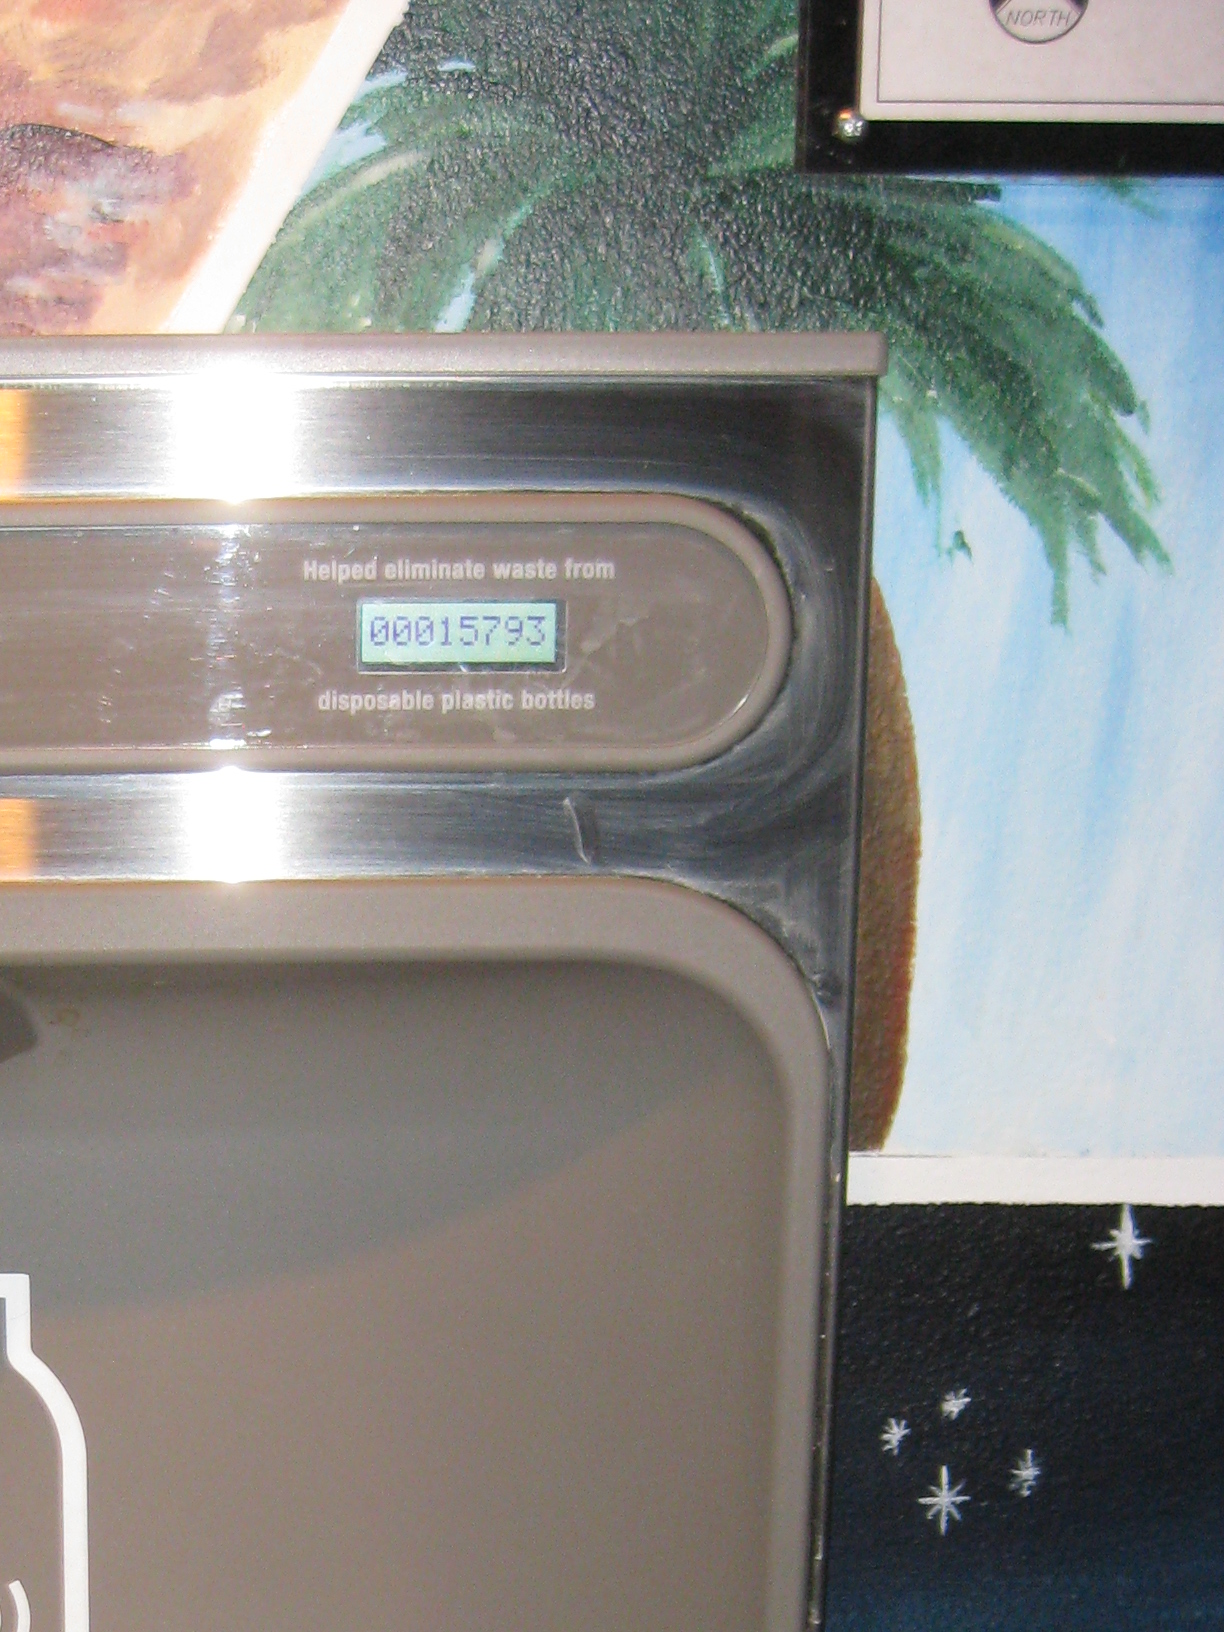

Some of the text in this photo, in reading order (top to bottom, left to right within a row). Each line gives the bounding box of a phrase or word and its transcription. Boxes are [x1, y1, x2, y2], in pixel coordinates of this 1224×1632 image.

[1005, 9, 1071, 27] NORTH
[303, 556, 616, 584] Helped eliminate waste from
[369, 615, 546, 647] 00015793
[317, 690, 597, 715] disposable plastic bottles
